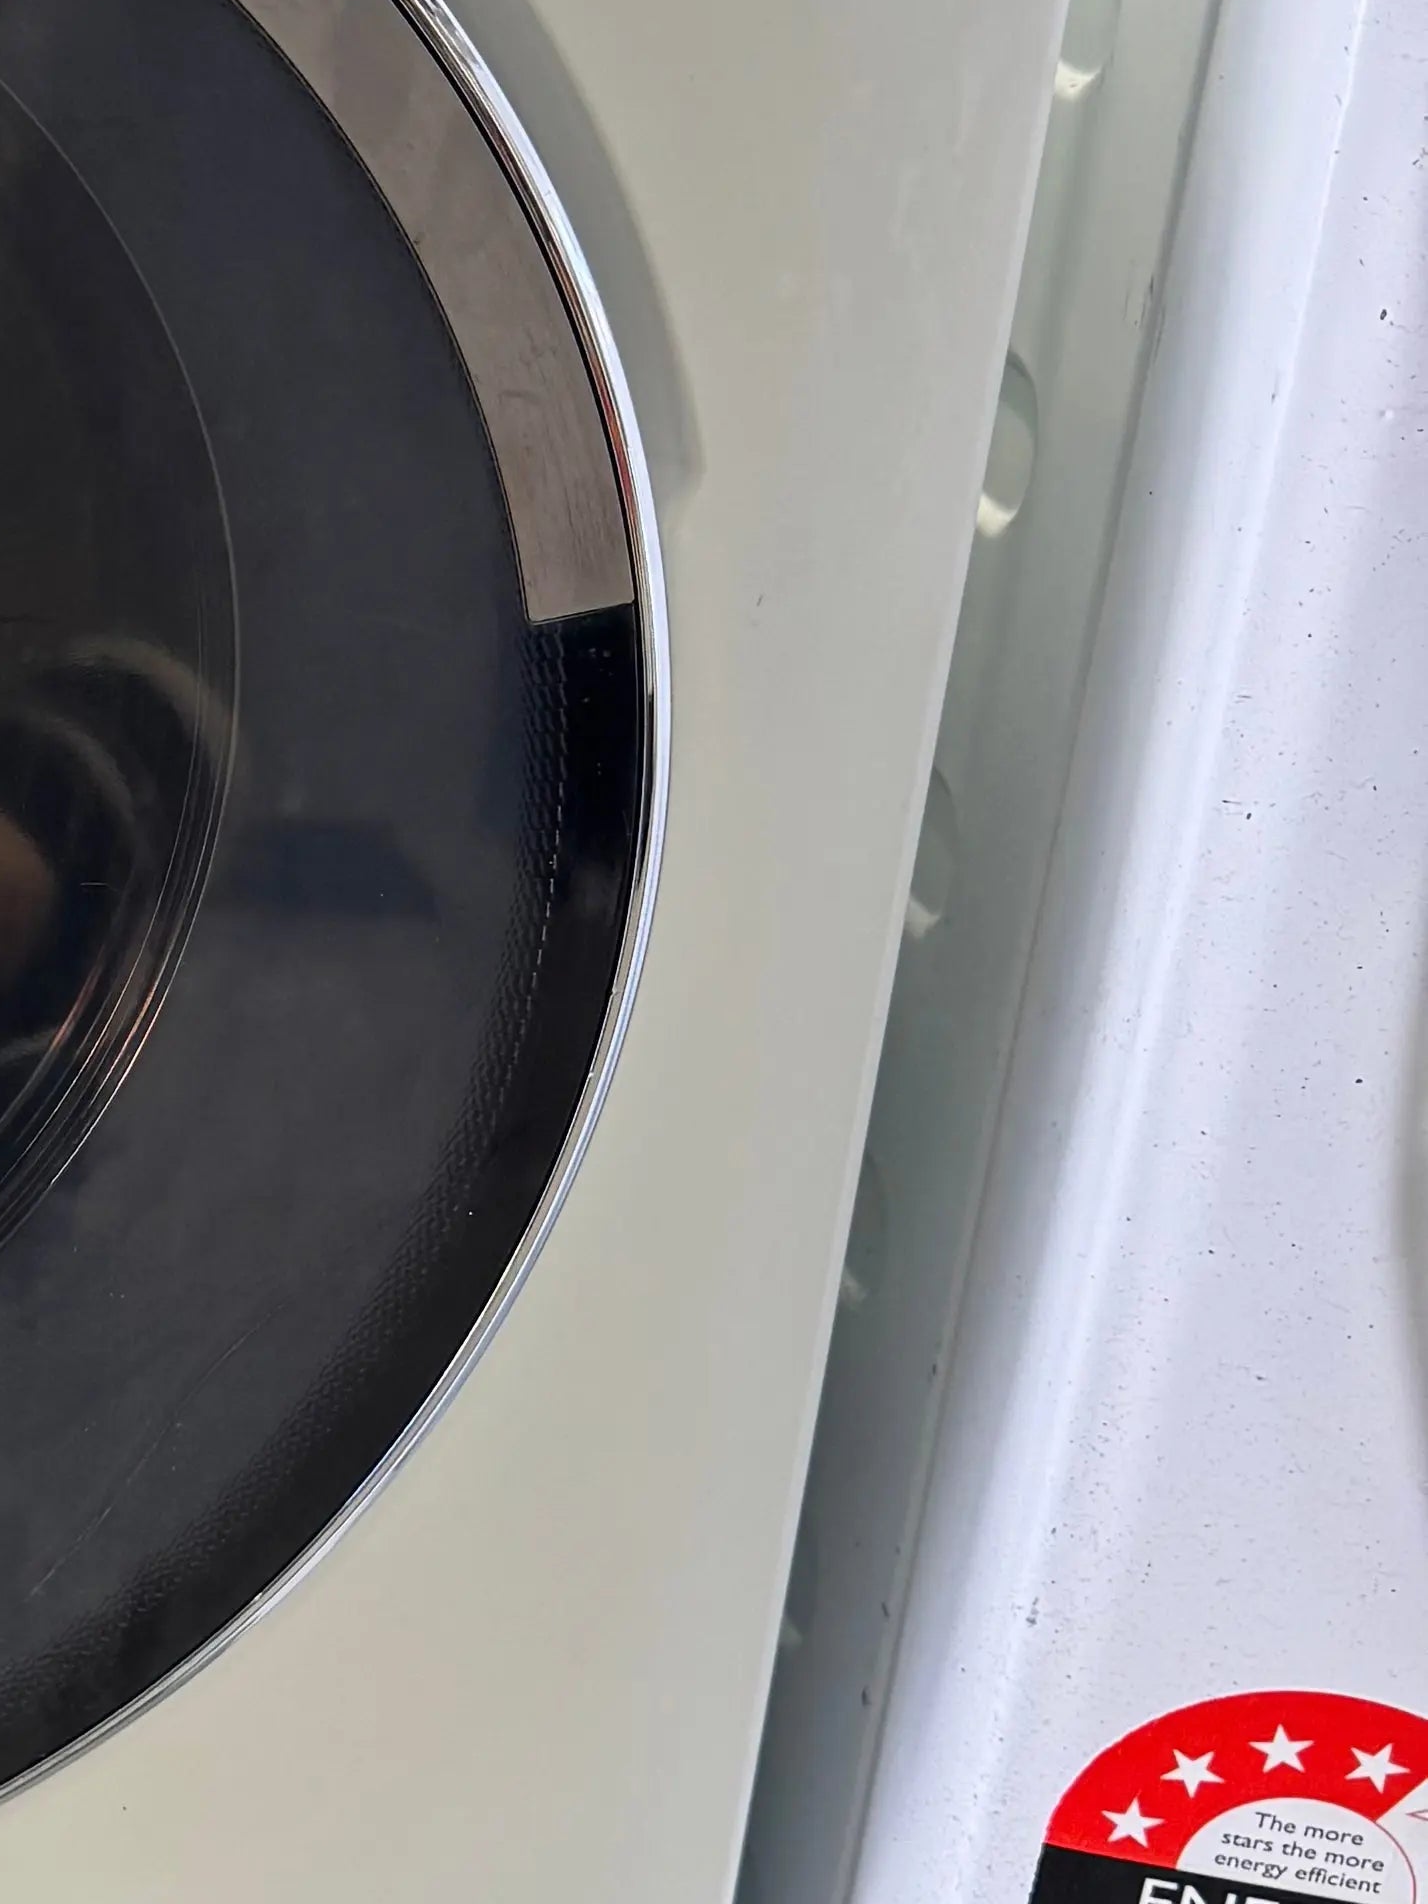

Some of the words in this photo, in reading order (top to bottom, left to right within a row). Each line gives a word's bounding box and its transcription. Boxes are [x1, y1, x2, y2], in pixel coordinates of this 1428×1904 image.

[1255, 1812, 1296, 1834] The
[1304, 1823, 1364, 1846] more
[1221, 1832, 1273, 1853] stars
[1282, 1842, 1316, 1860] the
[1324, 1851, 1385, 1872] more
[1215, 1853, 1287, 1880] energy
[1295, 1867, 1381, 1895] efficient
